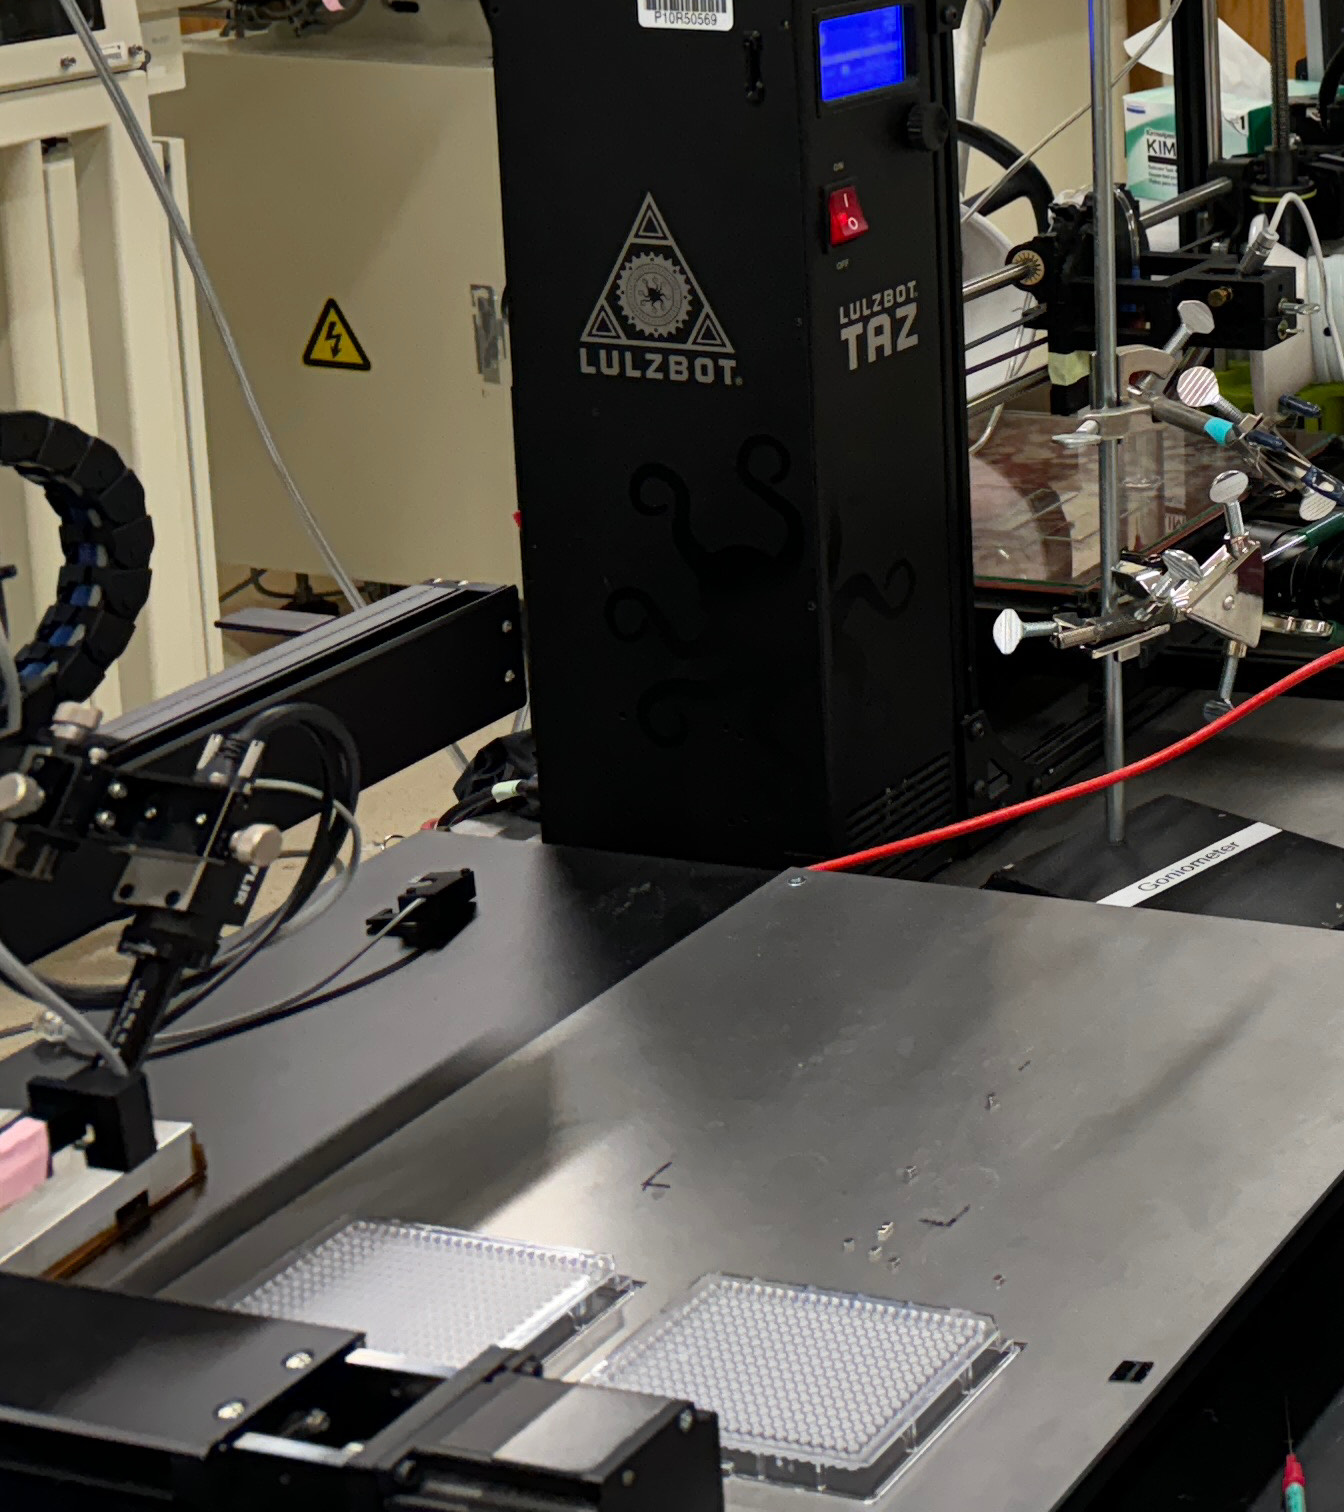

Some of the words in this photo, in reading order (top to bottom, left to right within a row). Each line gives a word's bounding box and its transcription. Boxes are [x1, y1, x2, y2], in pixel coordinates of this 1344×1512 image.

[654, 11, 718, 26] P10R50569
[833, 161, 845, 172] ON
[836, 258, 849, 270] OFF
[839, 281, 917, 324] LULZBOT
[840, 302, 919, 371] TAZ
[579, 348, 737, 385] LULZBOT
[1137, 841, 1240, 892] Goniometer
